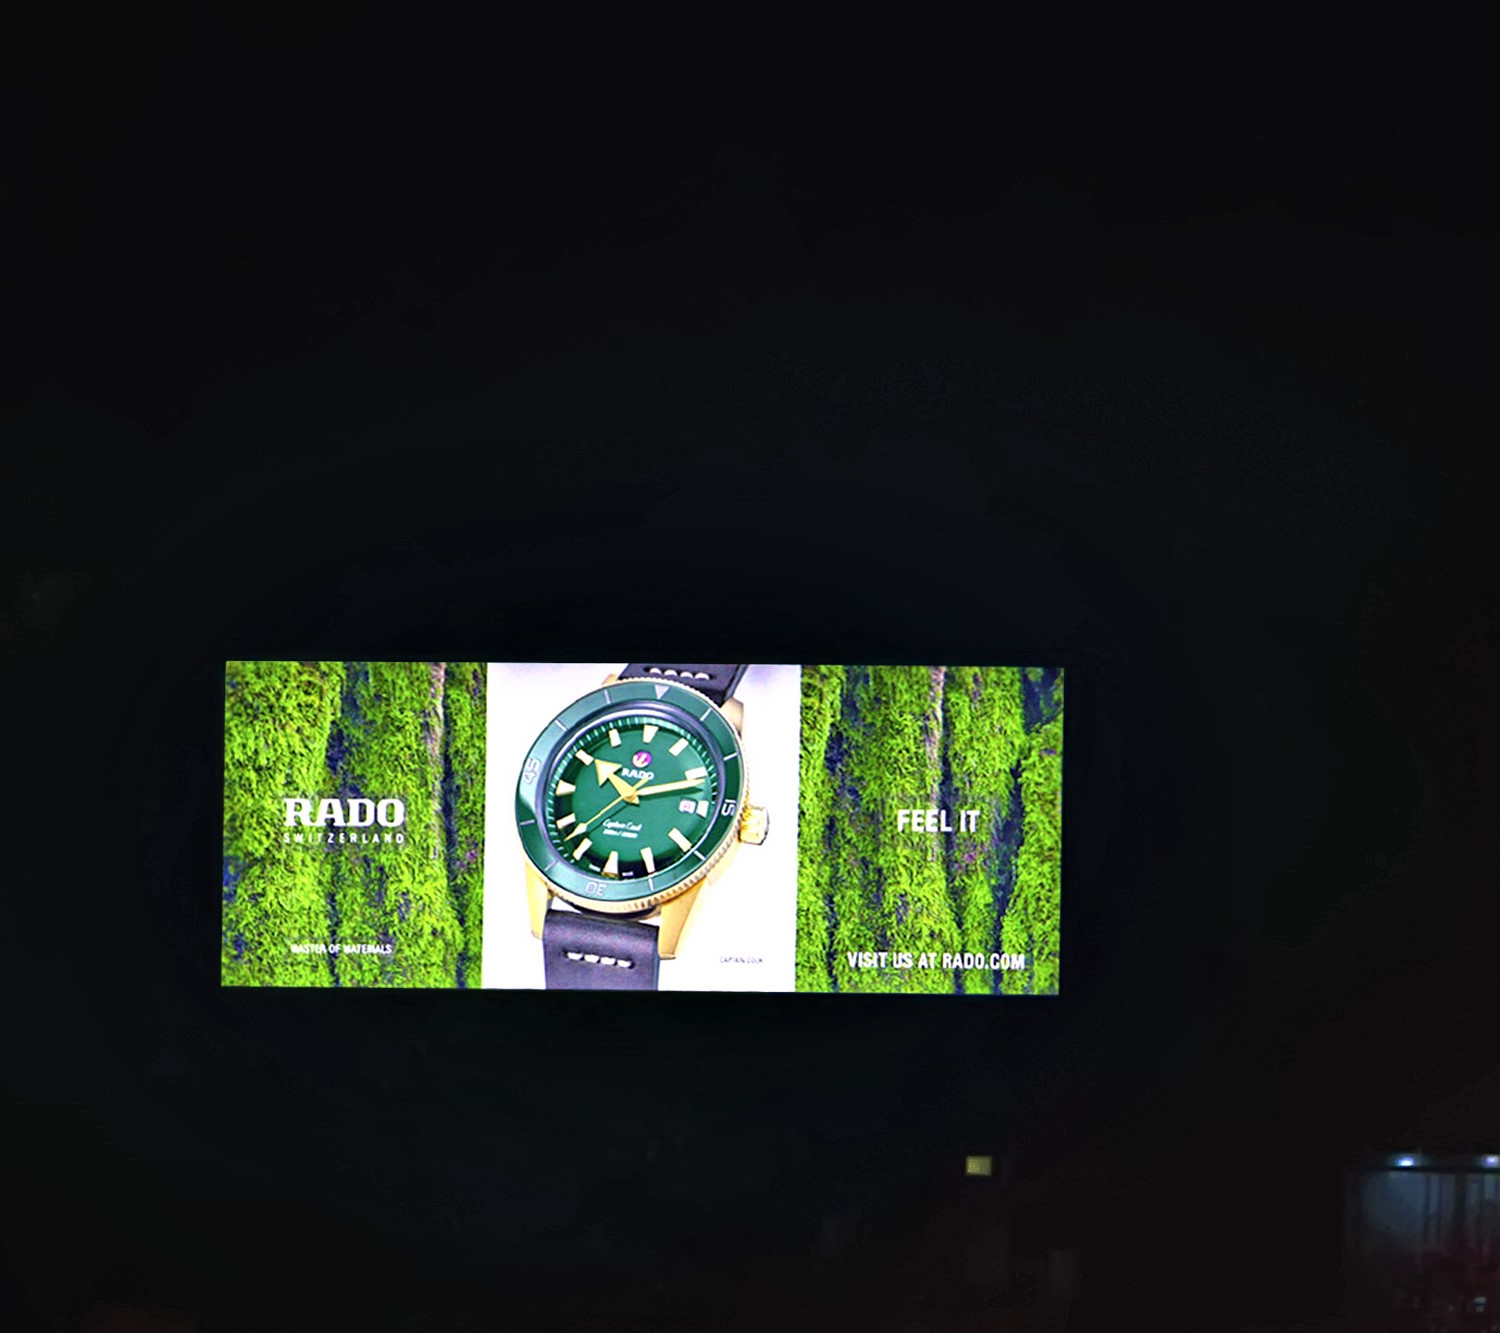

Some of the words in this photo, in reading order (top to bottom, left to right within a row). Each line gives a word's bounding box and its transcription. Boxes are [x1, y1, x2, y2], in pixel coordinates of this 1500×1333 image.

[621, 768, 654, 781] RADO
[283, 798, 405, 828] RADO
[897, 809, 952, 832] FEEL
[960, 809, 980, 832] IT
[283, 832, 405, 844] SWITZERLAND
[291, 944, 327, 954] MASTER
[328, 944, 341, 953] OF
[343, 944, 393, 955] MATERIALS
[847, 952, 887, 968] VISIT
[893, 952, 913, 969] US
[917, 953, 937, 969] AT
[942, 953, 1026, 970] RADO.COM
